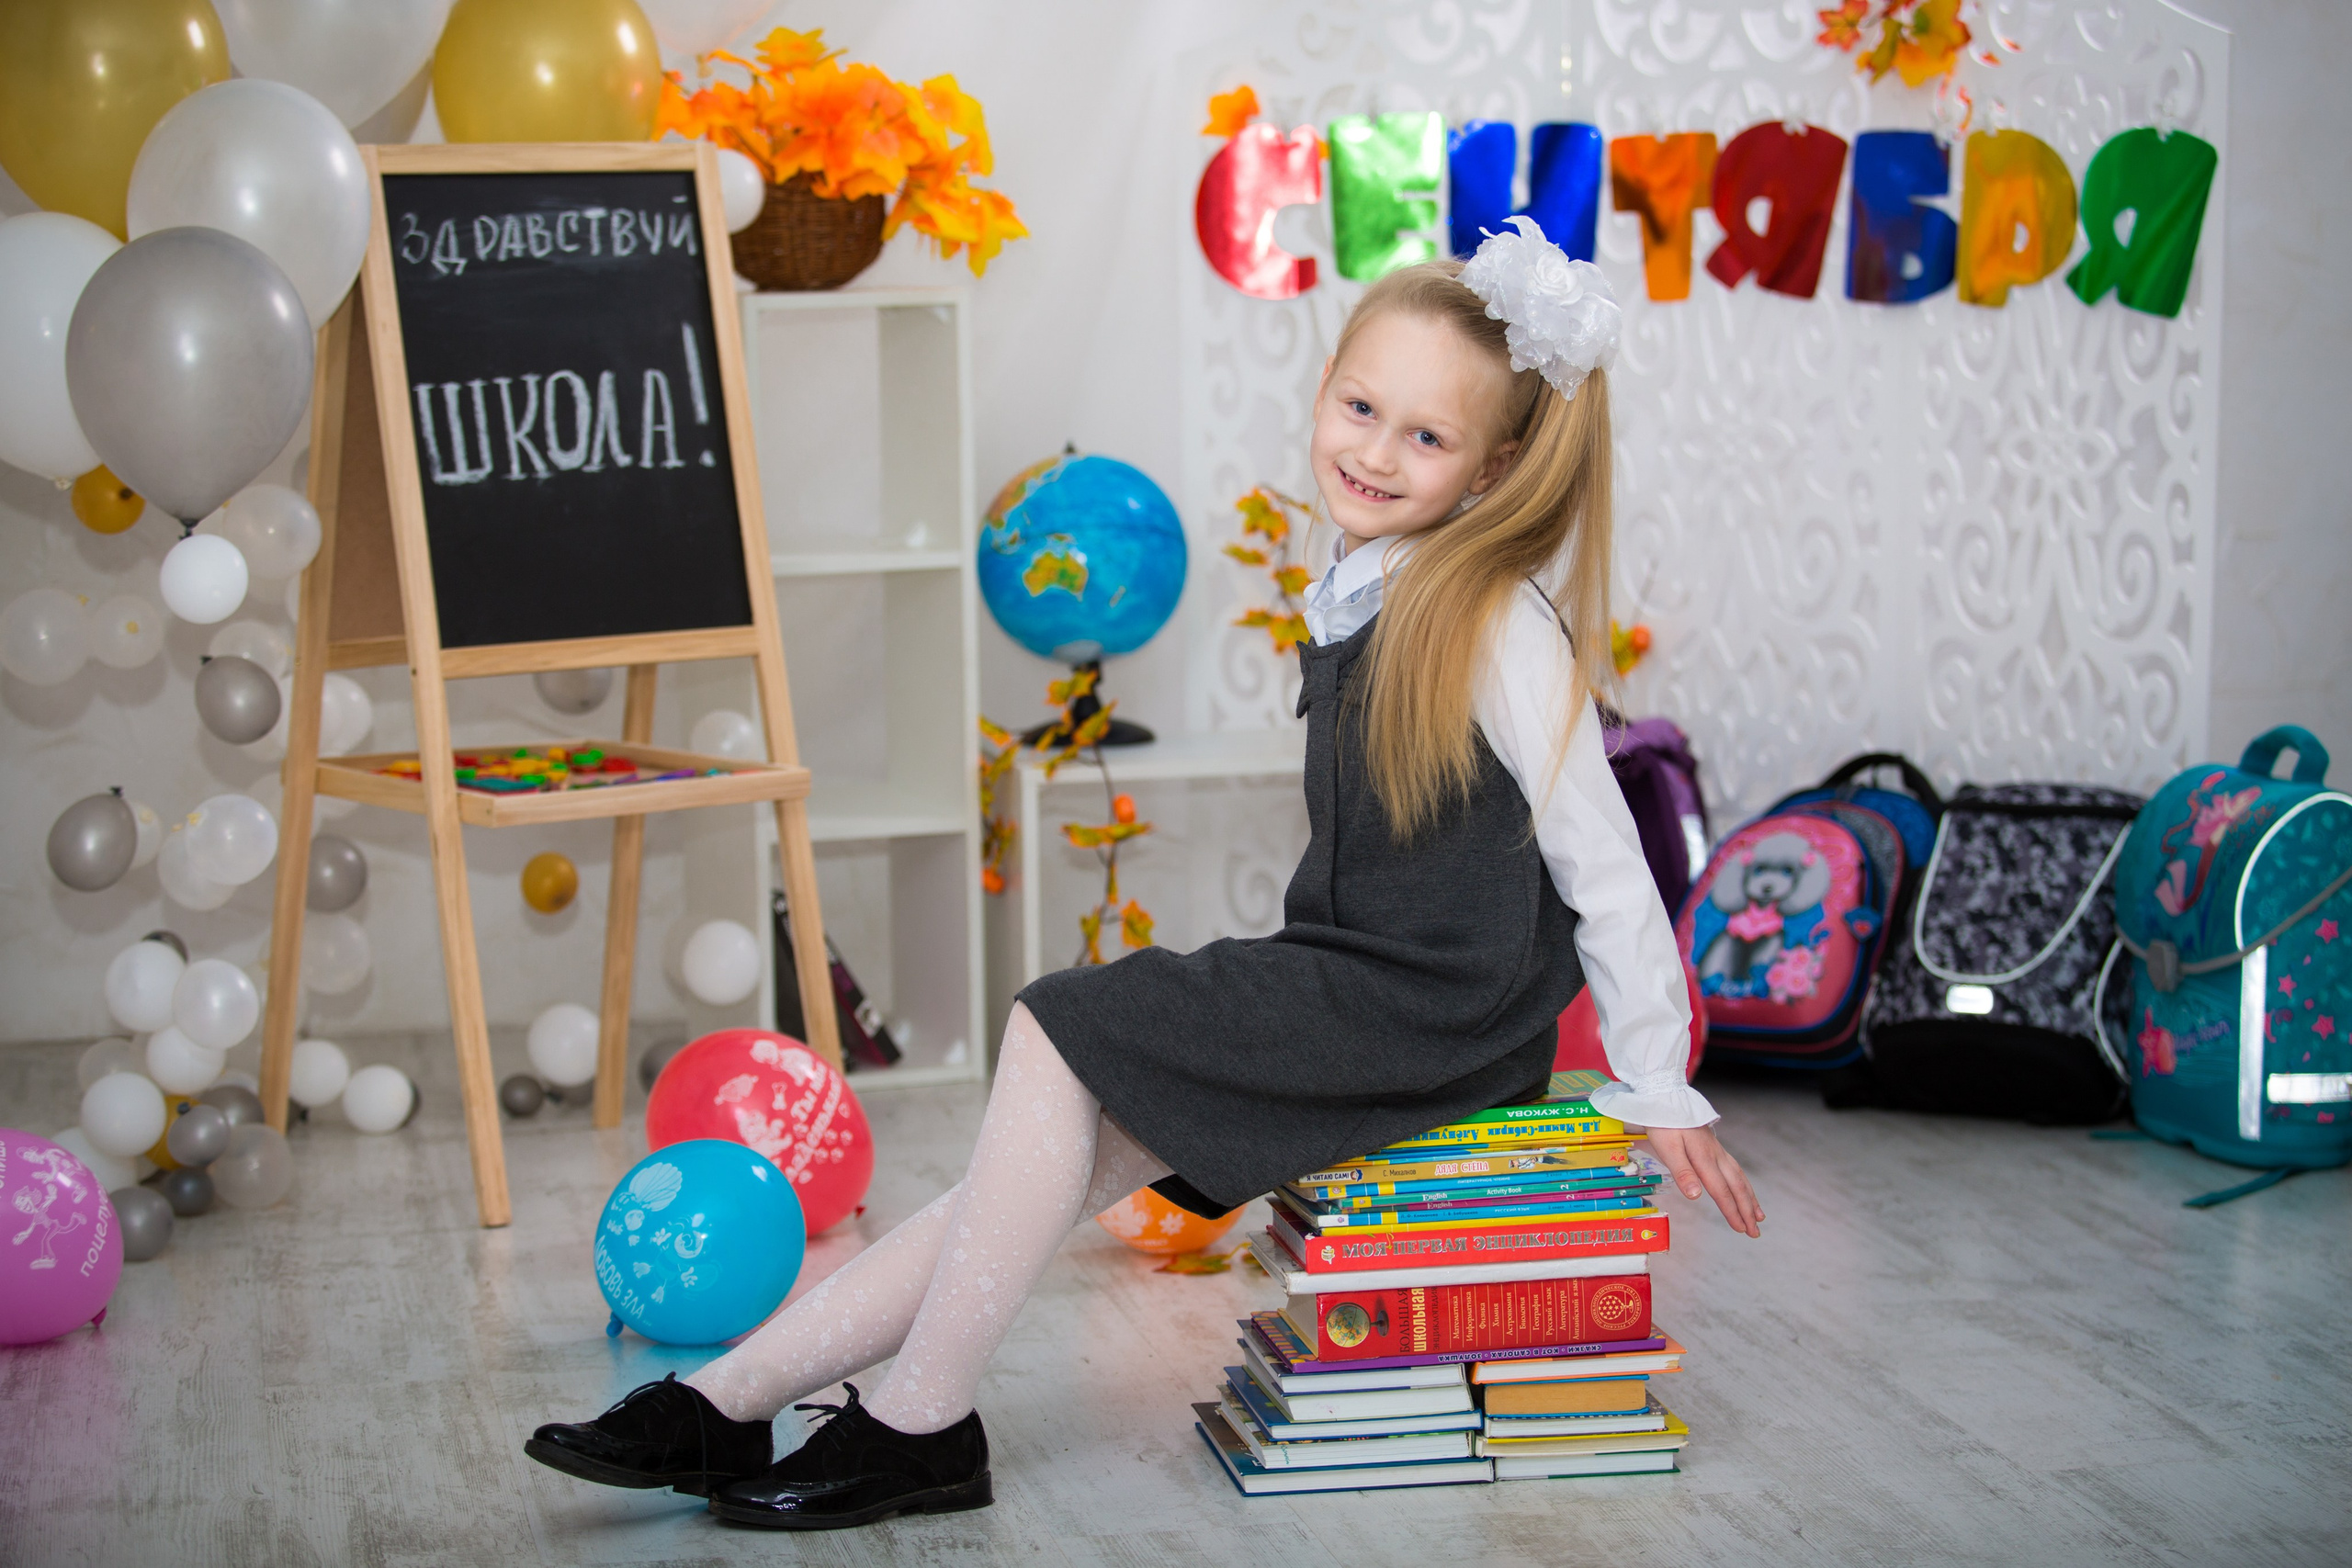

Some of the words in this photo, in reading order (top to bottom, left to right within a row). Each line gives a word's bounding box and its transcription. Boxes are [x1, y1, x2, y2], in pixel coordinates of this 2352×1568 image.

[401, 195, 699, 276] ЗДРАВСТВУЙ
[413, 322, 717, 485] ШКОЛА!
[1507, 1108, 1560, 1117] ЖУКОВА
[1312, 1173, 1333, 1181] ЧИТАЮ
[1389, 1168, 1417, 1177] Михалков
[1434, 1162, 1459, 1177] ДЯДЯ
[1461, 1160, 1490, 1174] СТЁПА
[1422, 1192, 1448, 1202] English
[1487, 1187, 1508, 1196] Activity
[1427, 1201, 1453, 1210] English
[1342, 1241, 1390, 1259] МОЯ
[1392, 1236, 1468, 1256] ПЕРВАЯ
[1472, 1228, 1635, 1251] ЭНЦИКЛОПЕДИЯ
[1466, 1292, 1475, 1342] Информатика
[1506, 1292, 1514, 1336] Астрономия
[1532, 1294, 1541, 1331] География
[1559, 1290, 1568, 1331] Литература
[1397, 1289, 1410, 1353] БОЛЬШАЯ
[1545, 1307, 1555, 1336] Русский
[1438, 1353, 1482, 1362] ЗОЛУШКА
[1542, 1347, 1559, 1355] КОТ
[1568, 1345, 1602, 1353] СКАЗКИ
